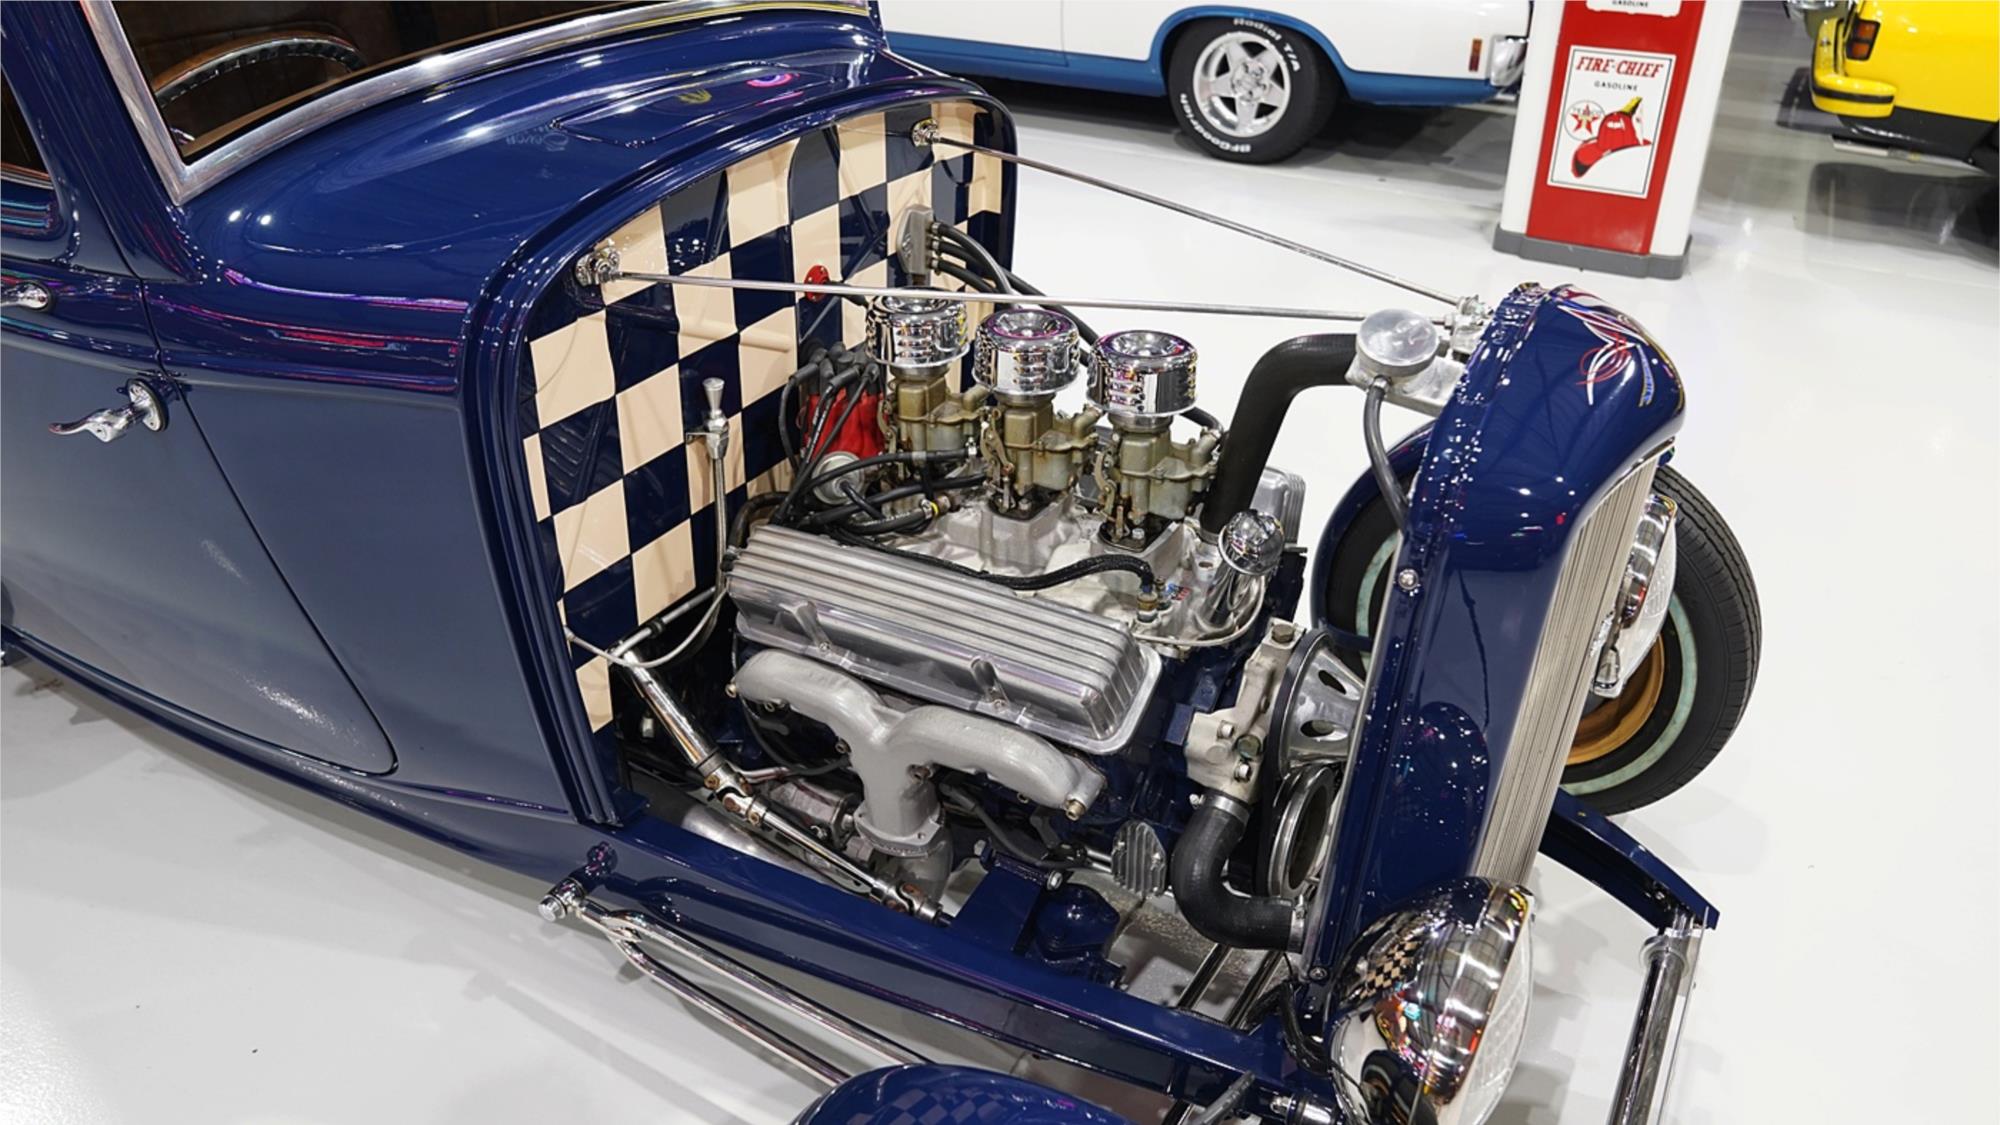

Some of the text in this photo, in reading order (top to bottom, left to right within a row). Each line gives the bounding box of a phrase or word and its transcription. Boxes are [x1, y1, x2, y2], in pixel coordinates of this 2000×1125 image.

[1233, 18, 1300, 72] Radial T/A
[1594, 81, 1638, 91] GASOLINE
